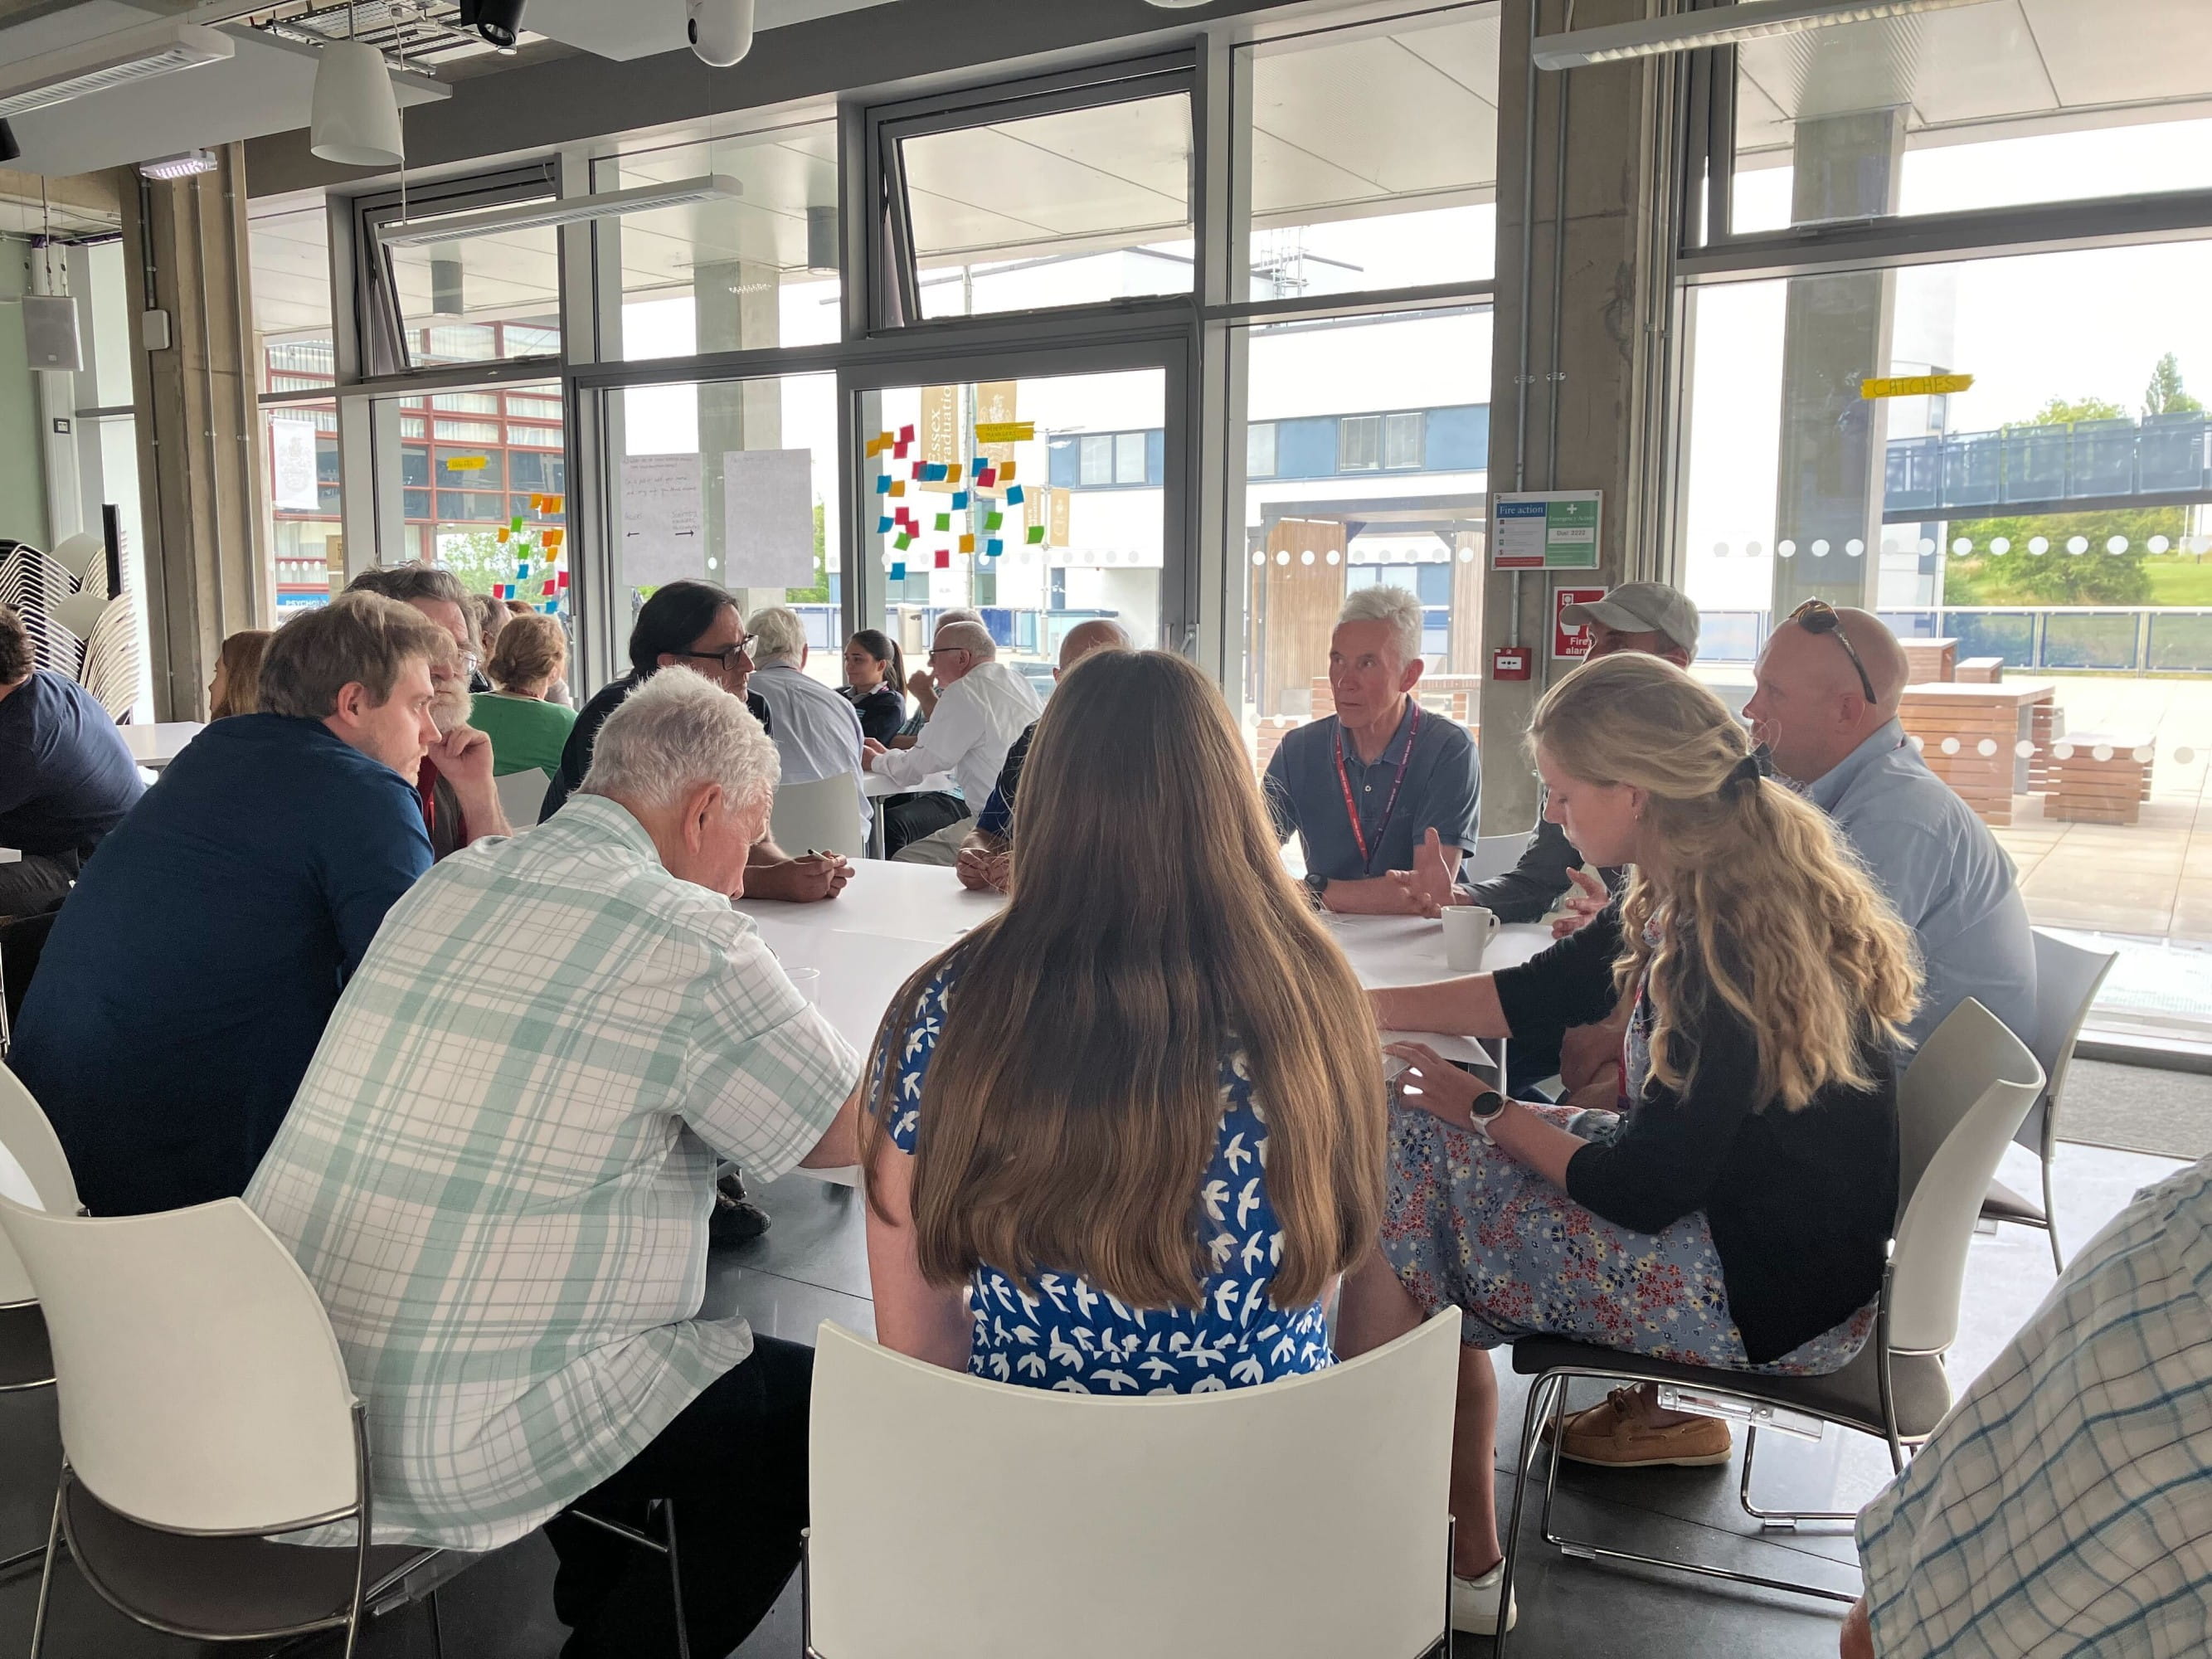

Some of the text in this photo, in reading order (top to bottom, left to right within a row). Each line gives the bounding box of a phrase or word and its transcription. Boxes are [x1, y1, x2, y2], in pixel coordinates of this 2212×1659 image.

[1873, 374, 1956, 396] CATCHES
[928, 408, 941, 463] Essex
[941, 386, 952, 465] raduatio
[1500, 504, 1544, 514] Fire action
[1570, 636, 1588, 645] Fire
